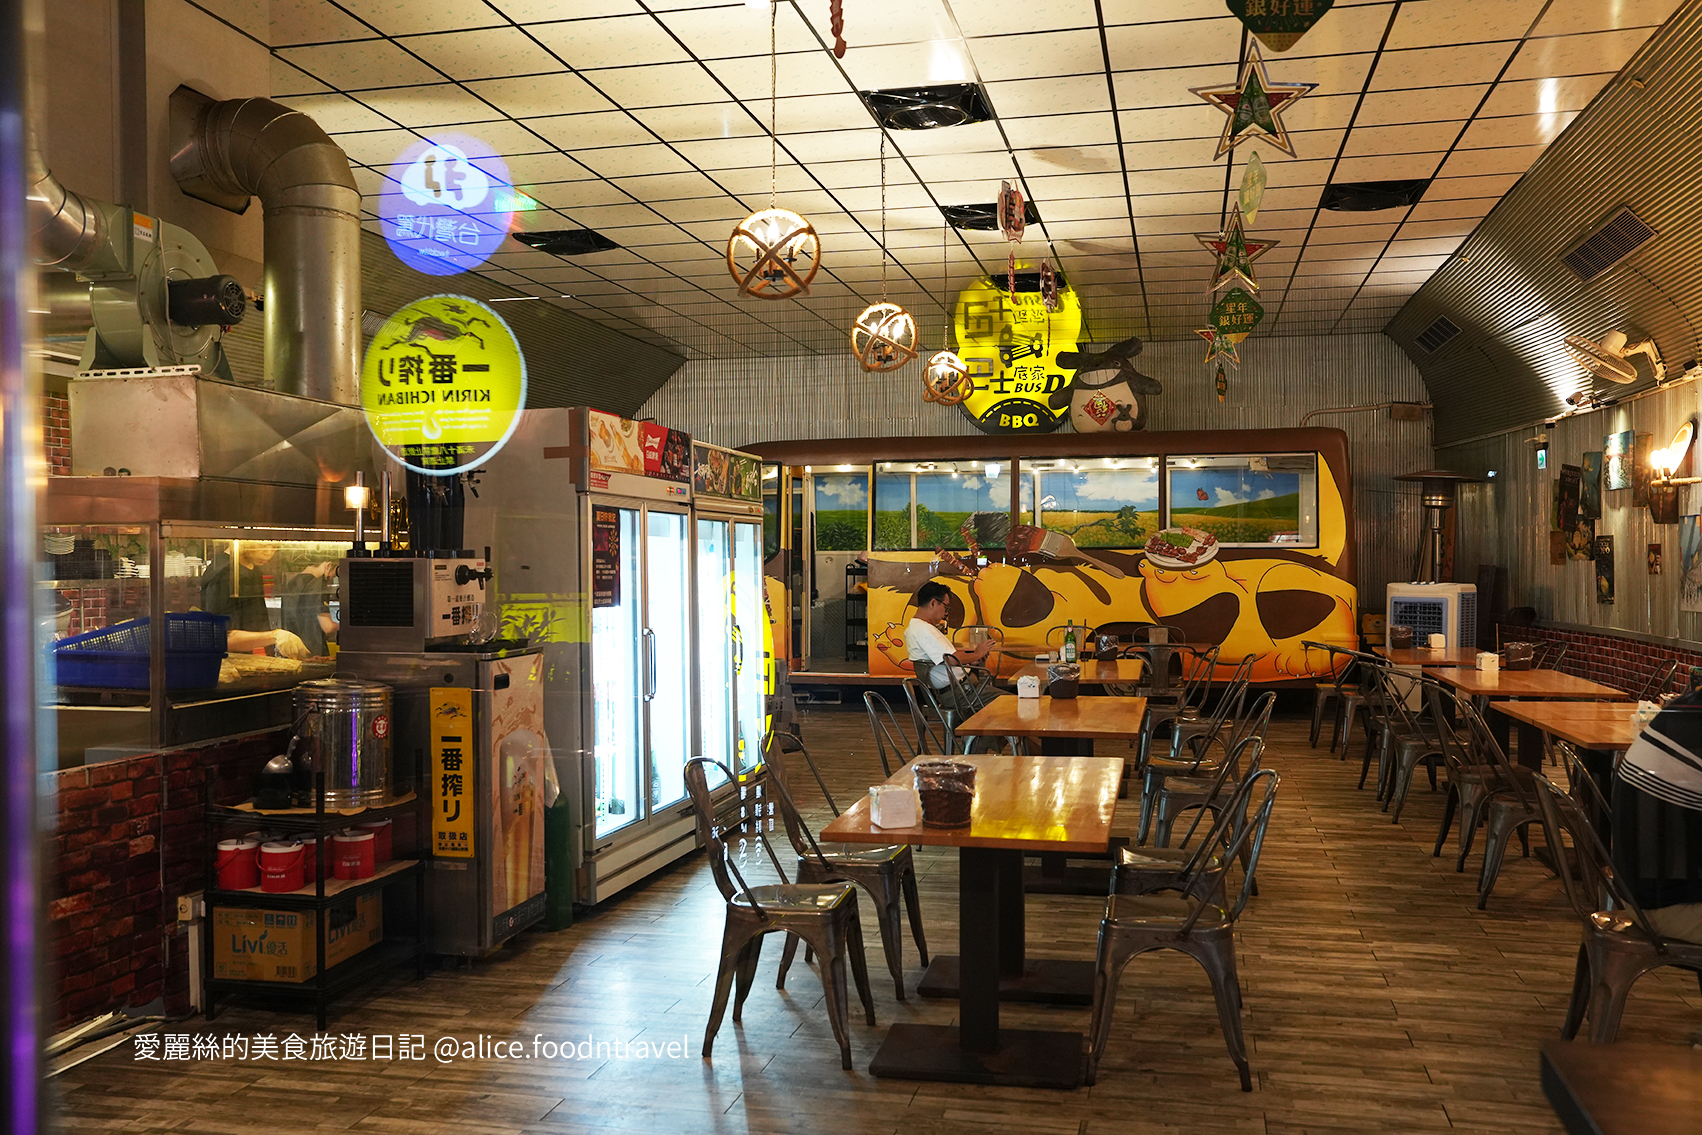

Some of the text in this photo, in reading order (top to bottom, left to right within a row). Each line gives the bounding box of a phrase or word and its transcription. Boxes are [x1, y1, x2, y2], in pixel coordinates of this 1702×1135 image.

[1219, 313, 1254, 327] 銀好運
[1013, 365, 1045, 381] 底家
[1014, 374, 1066, 394] BUS D
[999, 413, 1040, 429] BBQ
[441, 736, 463, 822] 一番搾り
[438, 832, 468, 841] 取扱店
[232, 930, 268, 954] Livi
